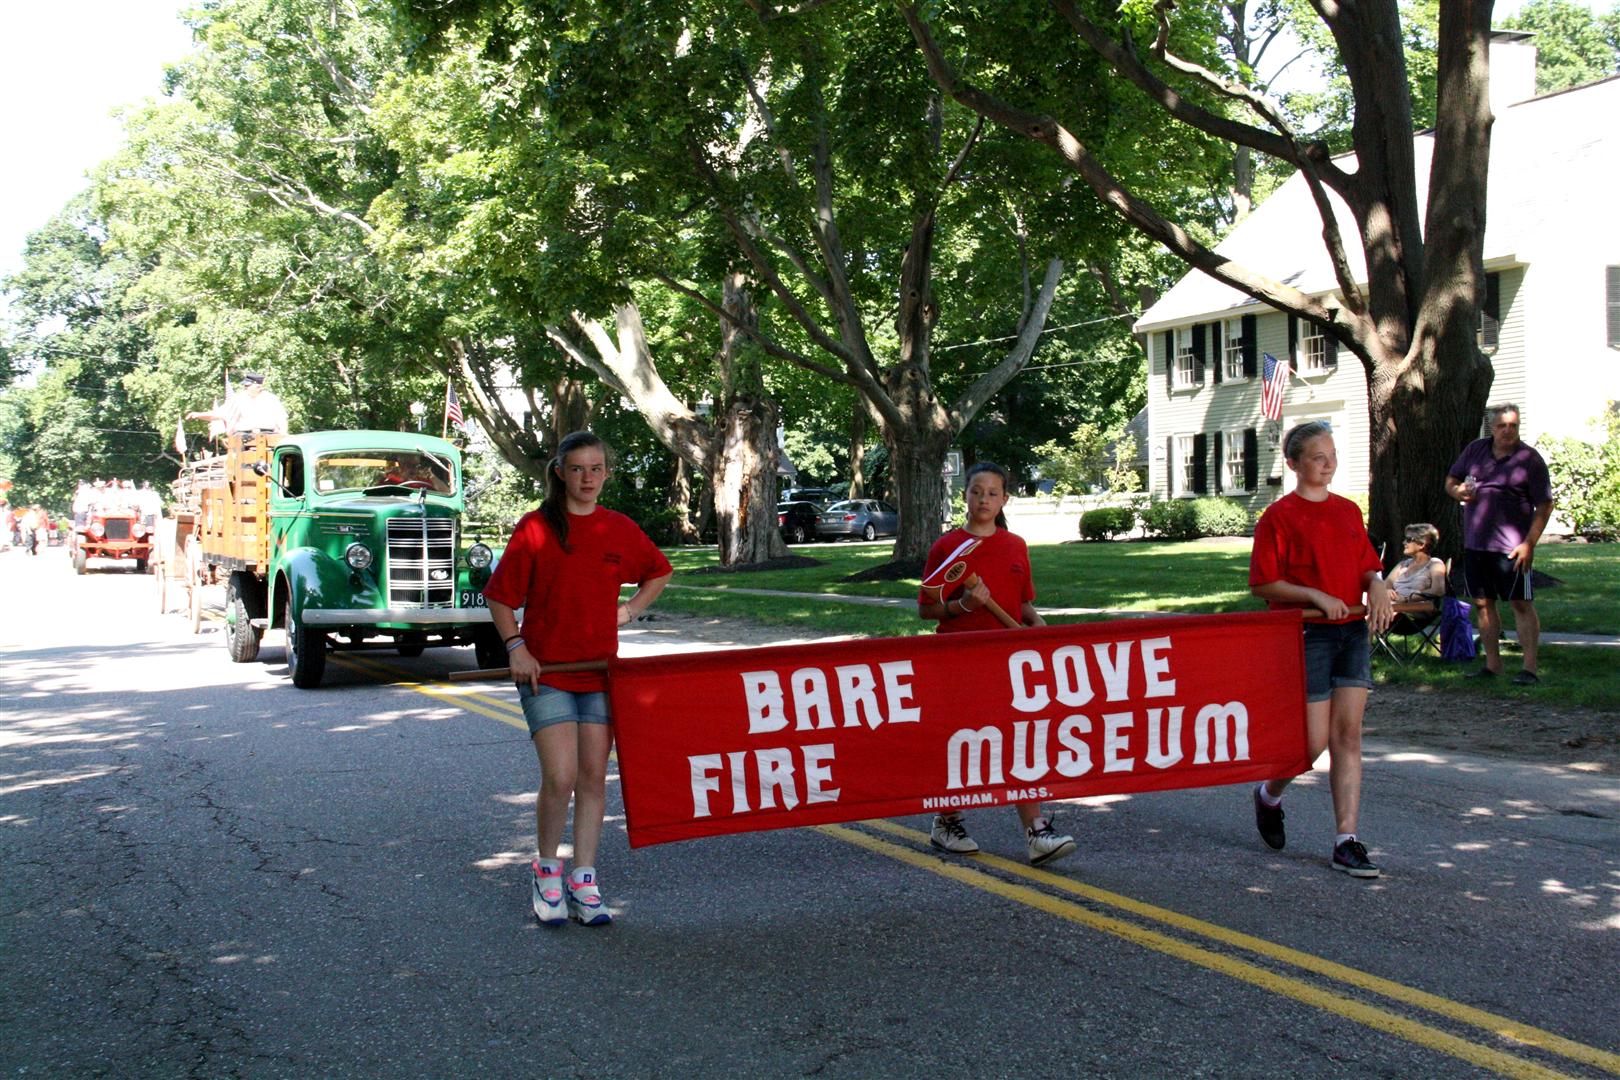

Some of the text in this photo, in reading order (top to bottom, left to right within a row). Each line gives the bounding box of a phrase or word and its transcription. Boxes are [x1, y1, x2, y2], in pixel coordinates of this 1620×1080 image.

[462, 592, 489, 606] 918
[740, 636, 1176, 734] BARE COVE
[687, 701, 1250, 818] FIRE MUSEUM
[923, 787, 1053, 809] HINGHAM, MASS.
